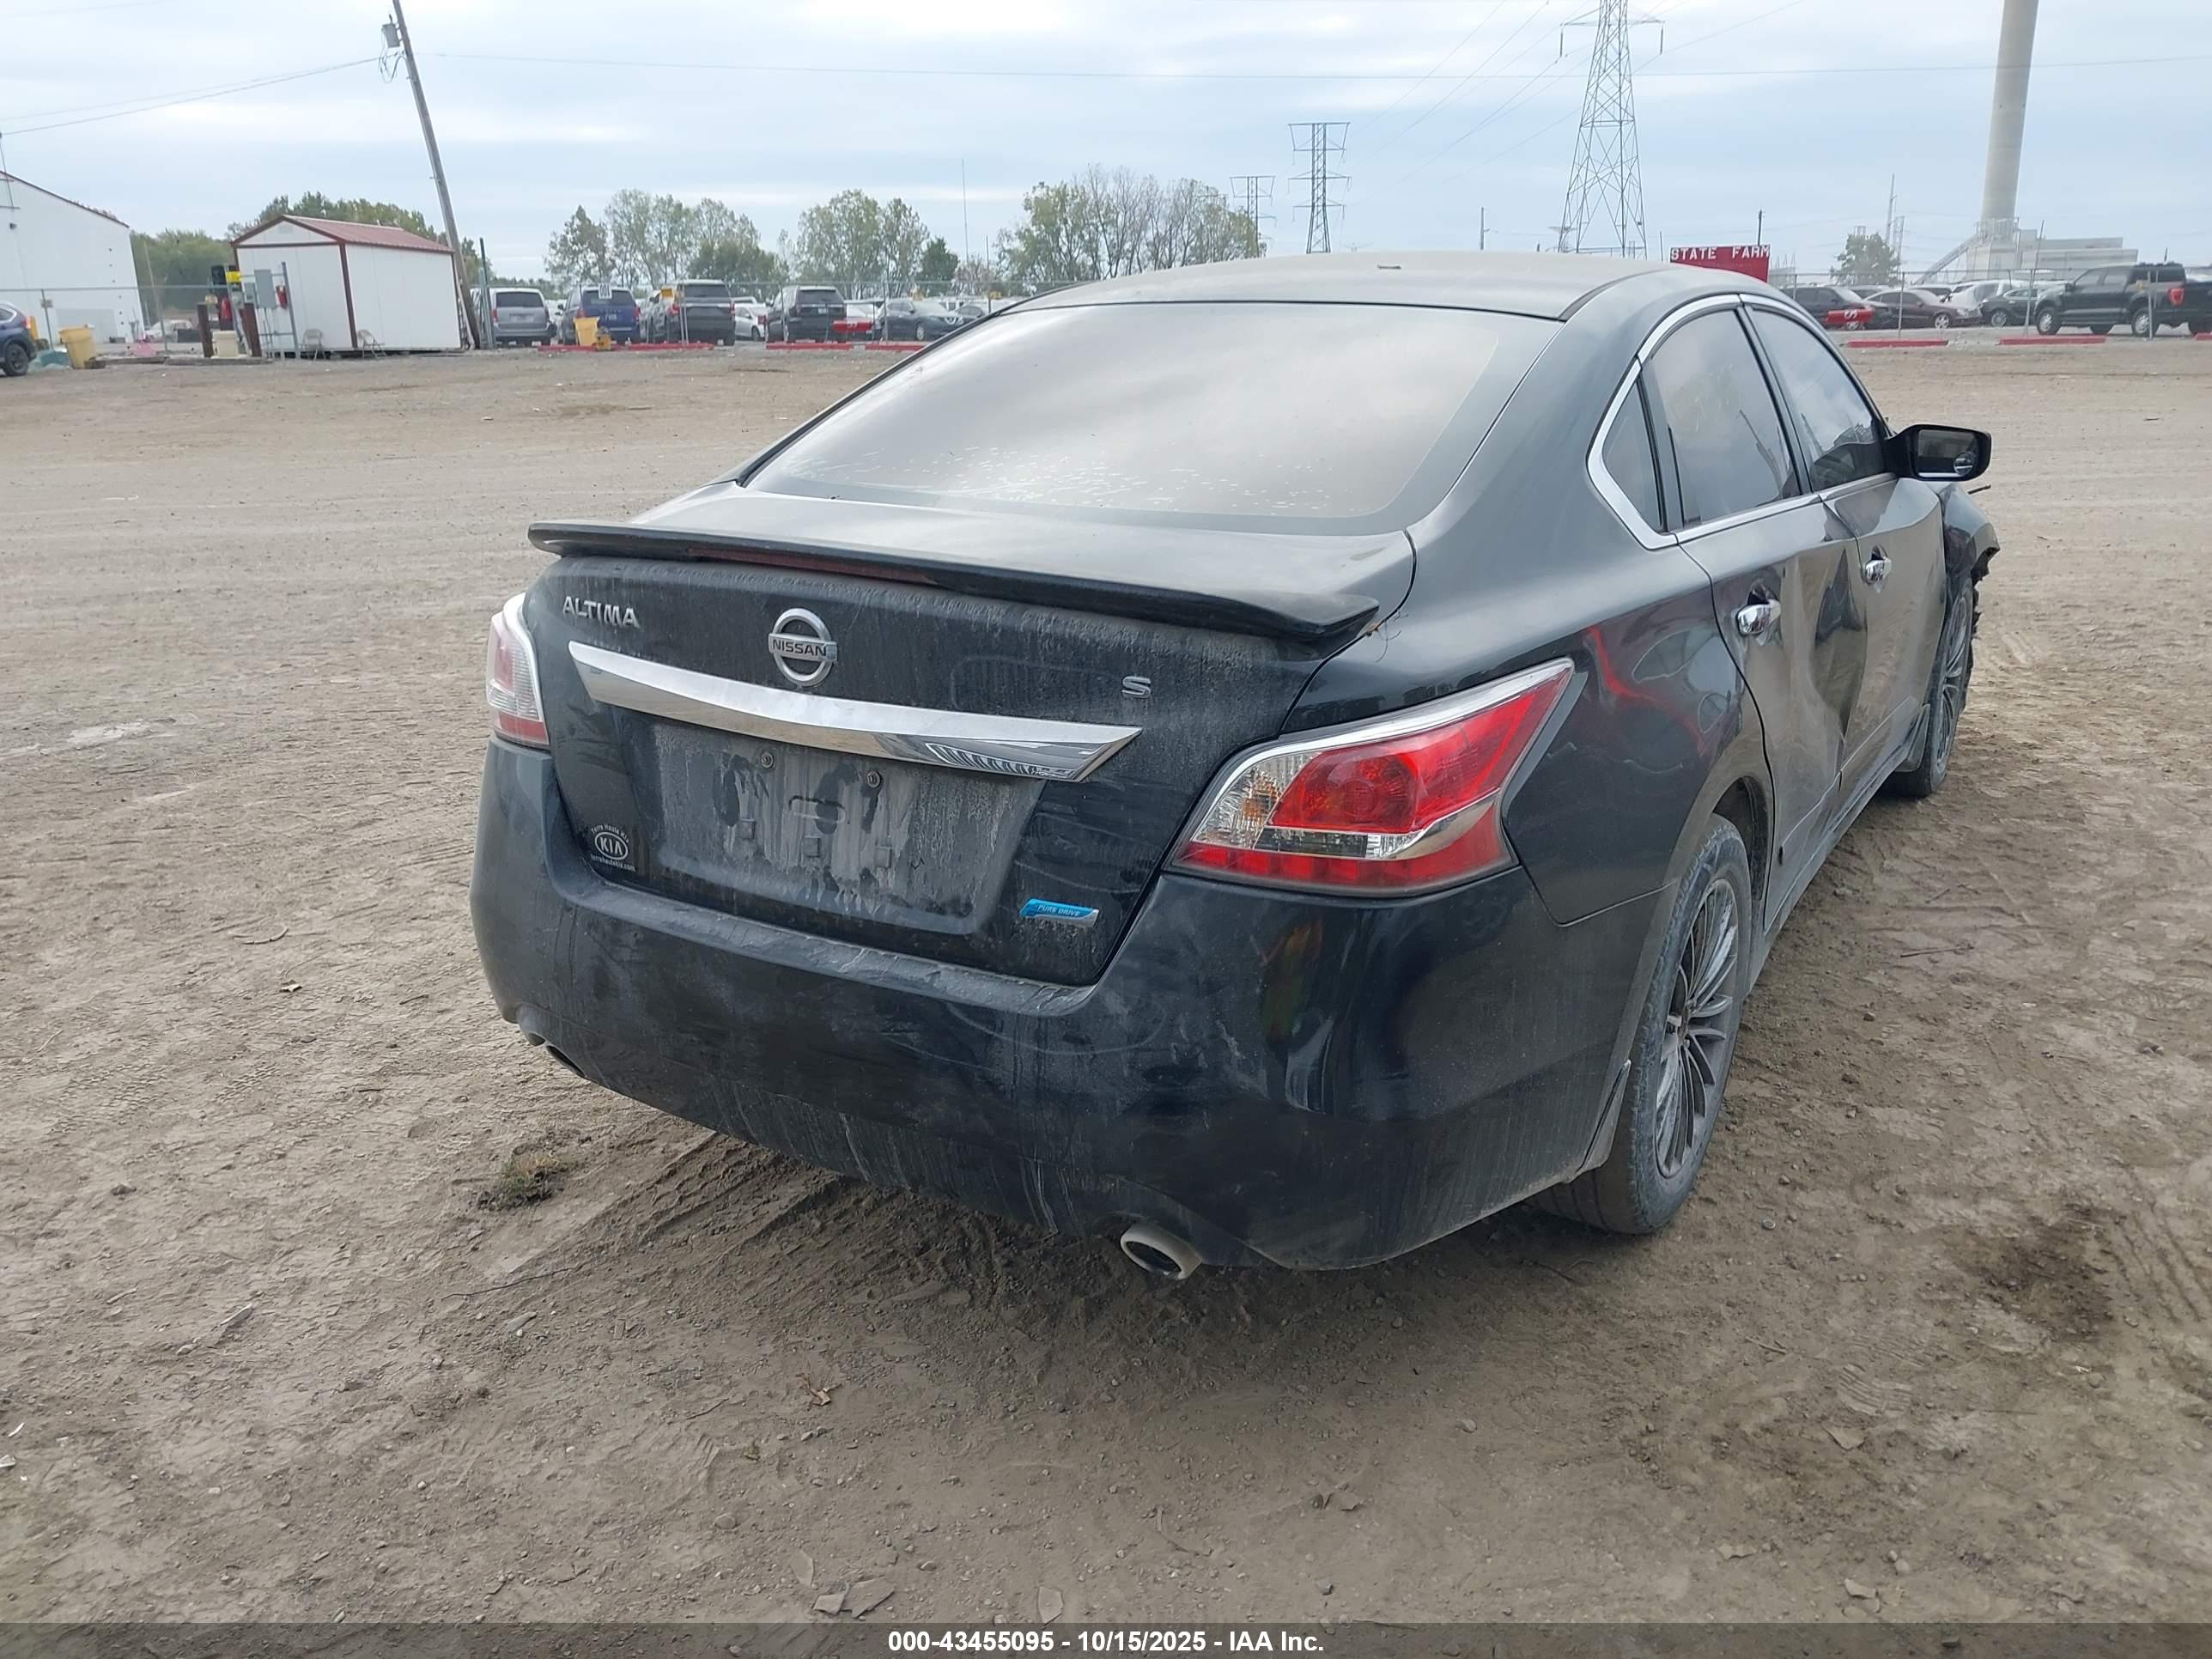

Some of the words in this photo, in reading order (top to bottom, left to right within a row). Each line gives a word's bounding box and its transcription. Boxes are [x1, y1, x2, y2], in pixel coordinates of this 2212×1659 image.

[1671, 246, 1717, 260] STATE
[1732, 245, 1770, 258] FARM
[562, 596, 641, 629] ALTIMA
[773, 638, 827, 657] NISSAN
[1121, 676, 1152, 699] S
[600, 836, 623, 856] KIA
[1037, 904, 1058, 915] PURE
[1057, 908, 1081, 917] DRIVE
